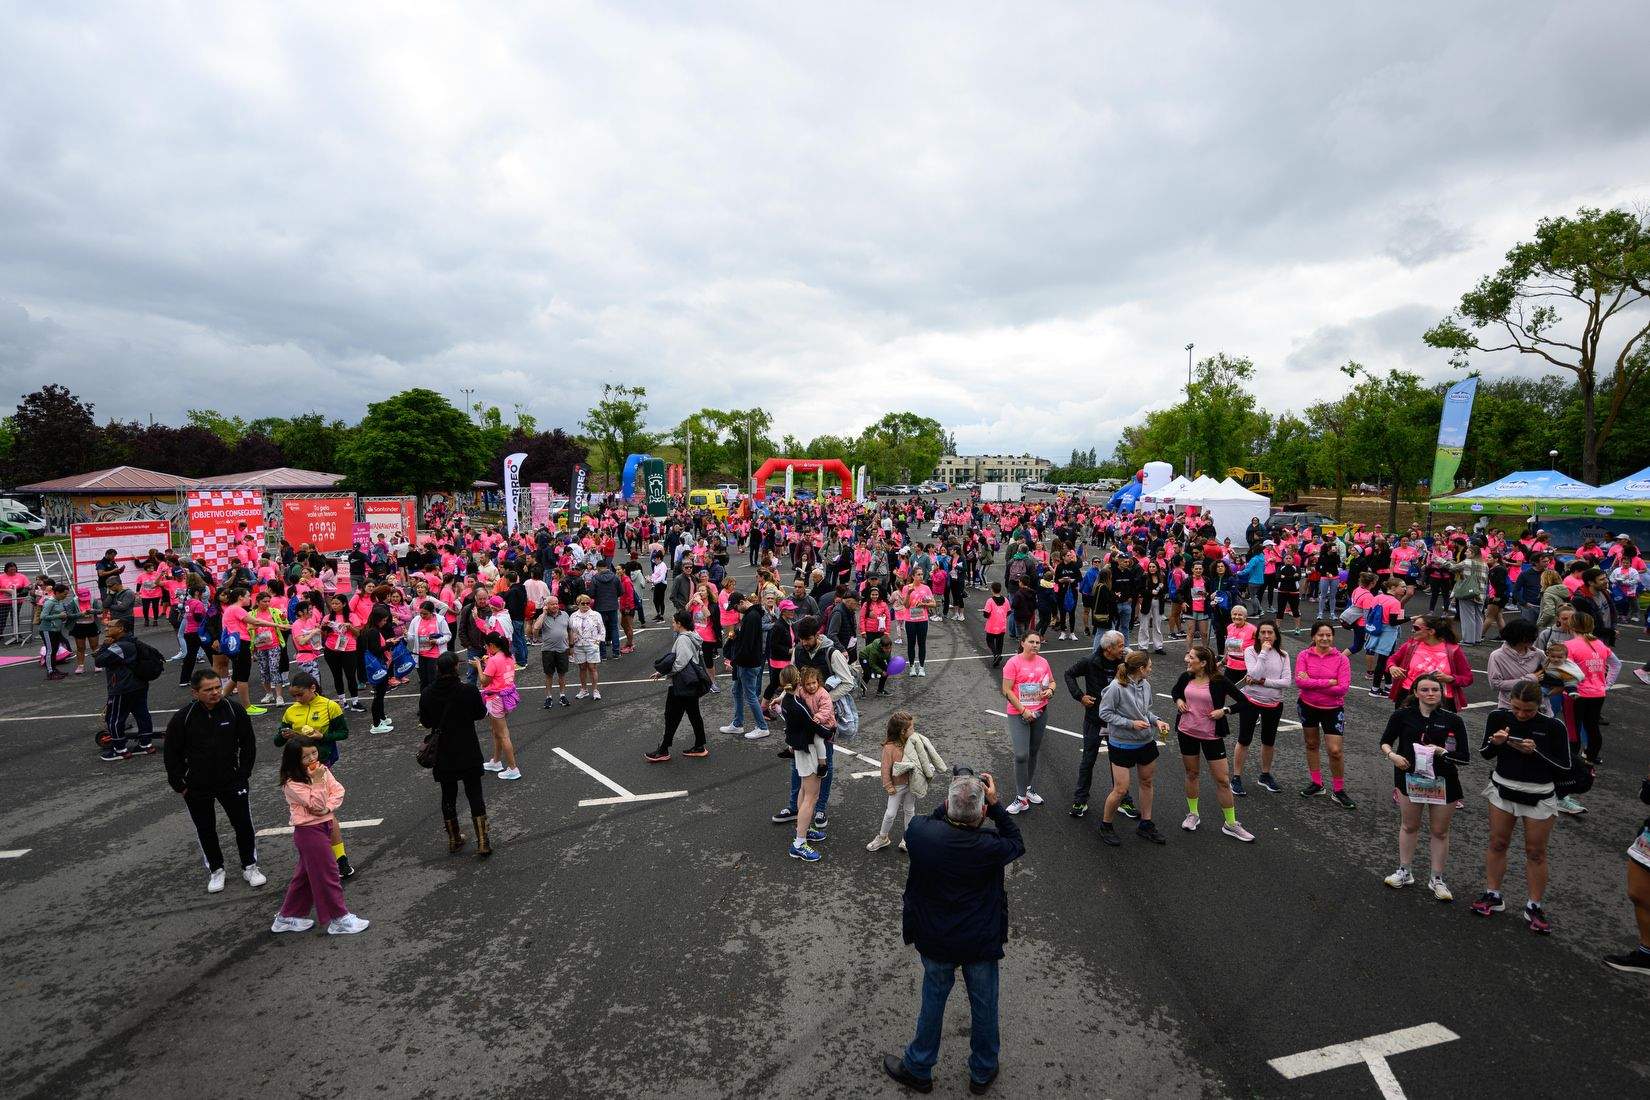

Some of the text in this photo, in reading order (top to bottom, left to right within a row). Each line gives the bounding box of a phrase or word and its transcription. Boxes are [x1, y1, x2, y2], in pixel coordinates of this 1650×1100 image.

[573, 469, 586, 523] EL CORREO
[192, 509, 262, 520] ¡OBJETIVO CONSEGUIDO!
